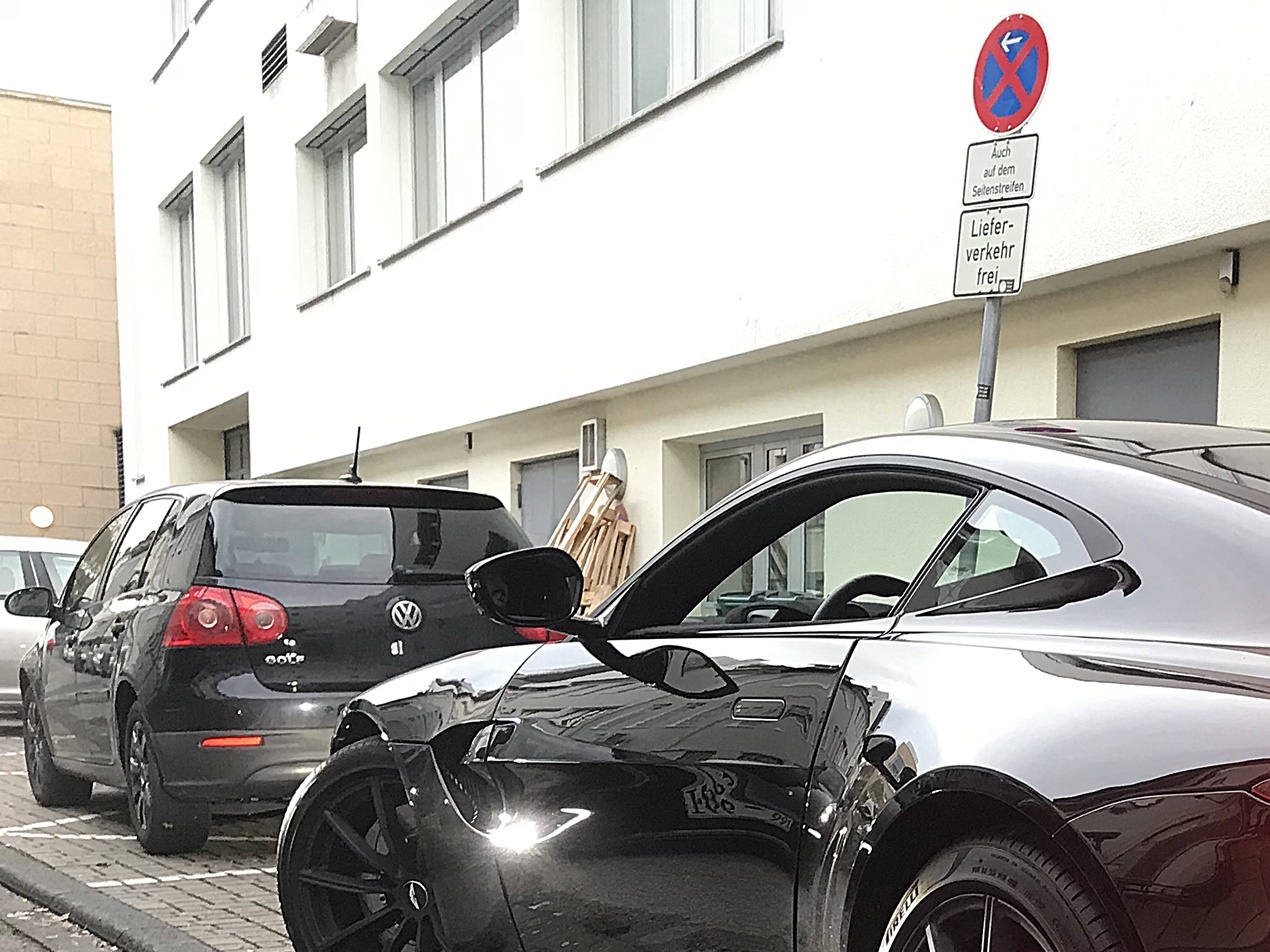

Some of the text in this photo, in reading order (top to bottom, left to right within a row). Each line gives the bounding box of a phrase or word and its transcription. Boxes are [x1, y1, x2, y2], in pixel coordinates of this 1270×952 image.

[991, 146, 1011, 159] Auch
[983, 164, 1016, 178] auf dem
[972, 181, 1024, 197] Seitenstreifen
[971, 217, 1014, 238] Liefer-
[966, 240, 1015, 262] verkehr
[976, 266, 999, 287] frei
